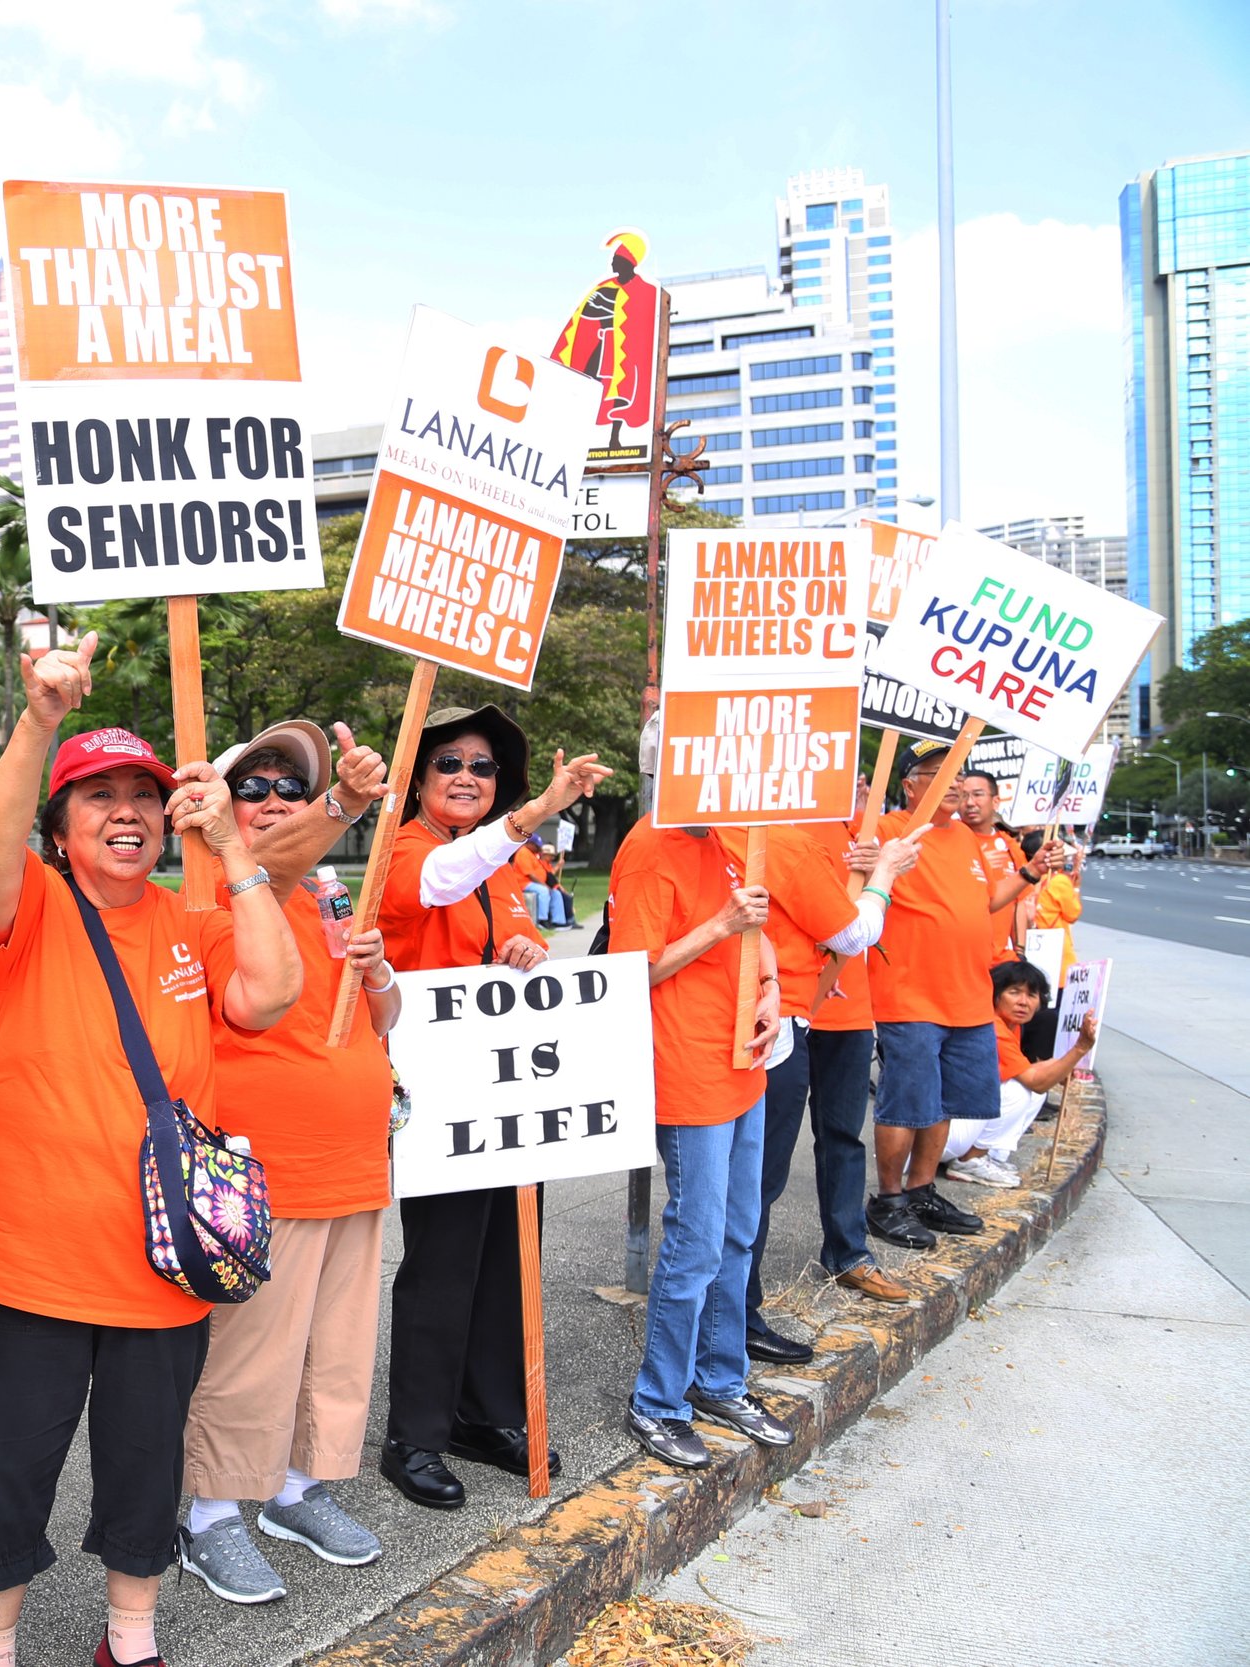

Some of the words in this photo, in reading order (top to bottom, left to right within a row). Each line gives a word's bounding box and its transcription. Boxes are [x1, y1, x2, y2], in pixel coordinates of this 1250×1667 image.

[80, 192, 225, 253] MORE
[19, 247, 164, 307] THAN
[173, 251, 284, 310] JUST
[77, 305, 112, 363] A
[122, 306, 253, 364] MEAL
[31, 418, 196, 485] HONK
[206, 416, 304, 480] FOR
[400, 397, 570, 499] LANAKILA
[609, 449, 640, 457] BUREAU
[385, 444, 439, 478] MEALS
[441, 461, 464, 485] ON
[466, 476, 527, 512] WHEELS
[528, 501, 546, 520] and
[47, 499, 306, 573] SENIORS!
[393, 489, 540, 581] LANAKILA
[696, 541, 846, 578] LANAKILA
[379, 532, 486, 606] MEALS
[489, 570, 535, 624] ON
[693, 579, 802, 618] MEALS
[805, 579, 846, 616] ON
[367, 575, 496, 656] WHEELS
[687, 617, 813, 657] WHEELS
[970, 576, 1093, 652] FUND
[919, 597, 1097, 703] KUPUNA
[863, 675, 964, 731] NIORS!
[930, 646, 1054, 722] CARE
[715, 694, 811, 737] MORE
[669, 734, 767, 776] THAN
[769, 731, 851, 772] JUST
[1044, 763, 1091, 778] FD
[697, 773, 722, 813] A
[729, 769, 817, 812] MEAL
[1026, 780, 1098, 795] KUNA
[427, 969, 608, 1023] FOOD
[491, 1039, 560, 1084] IS
[445, 1099, 618, 1157] LIFE
